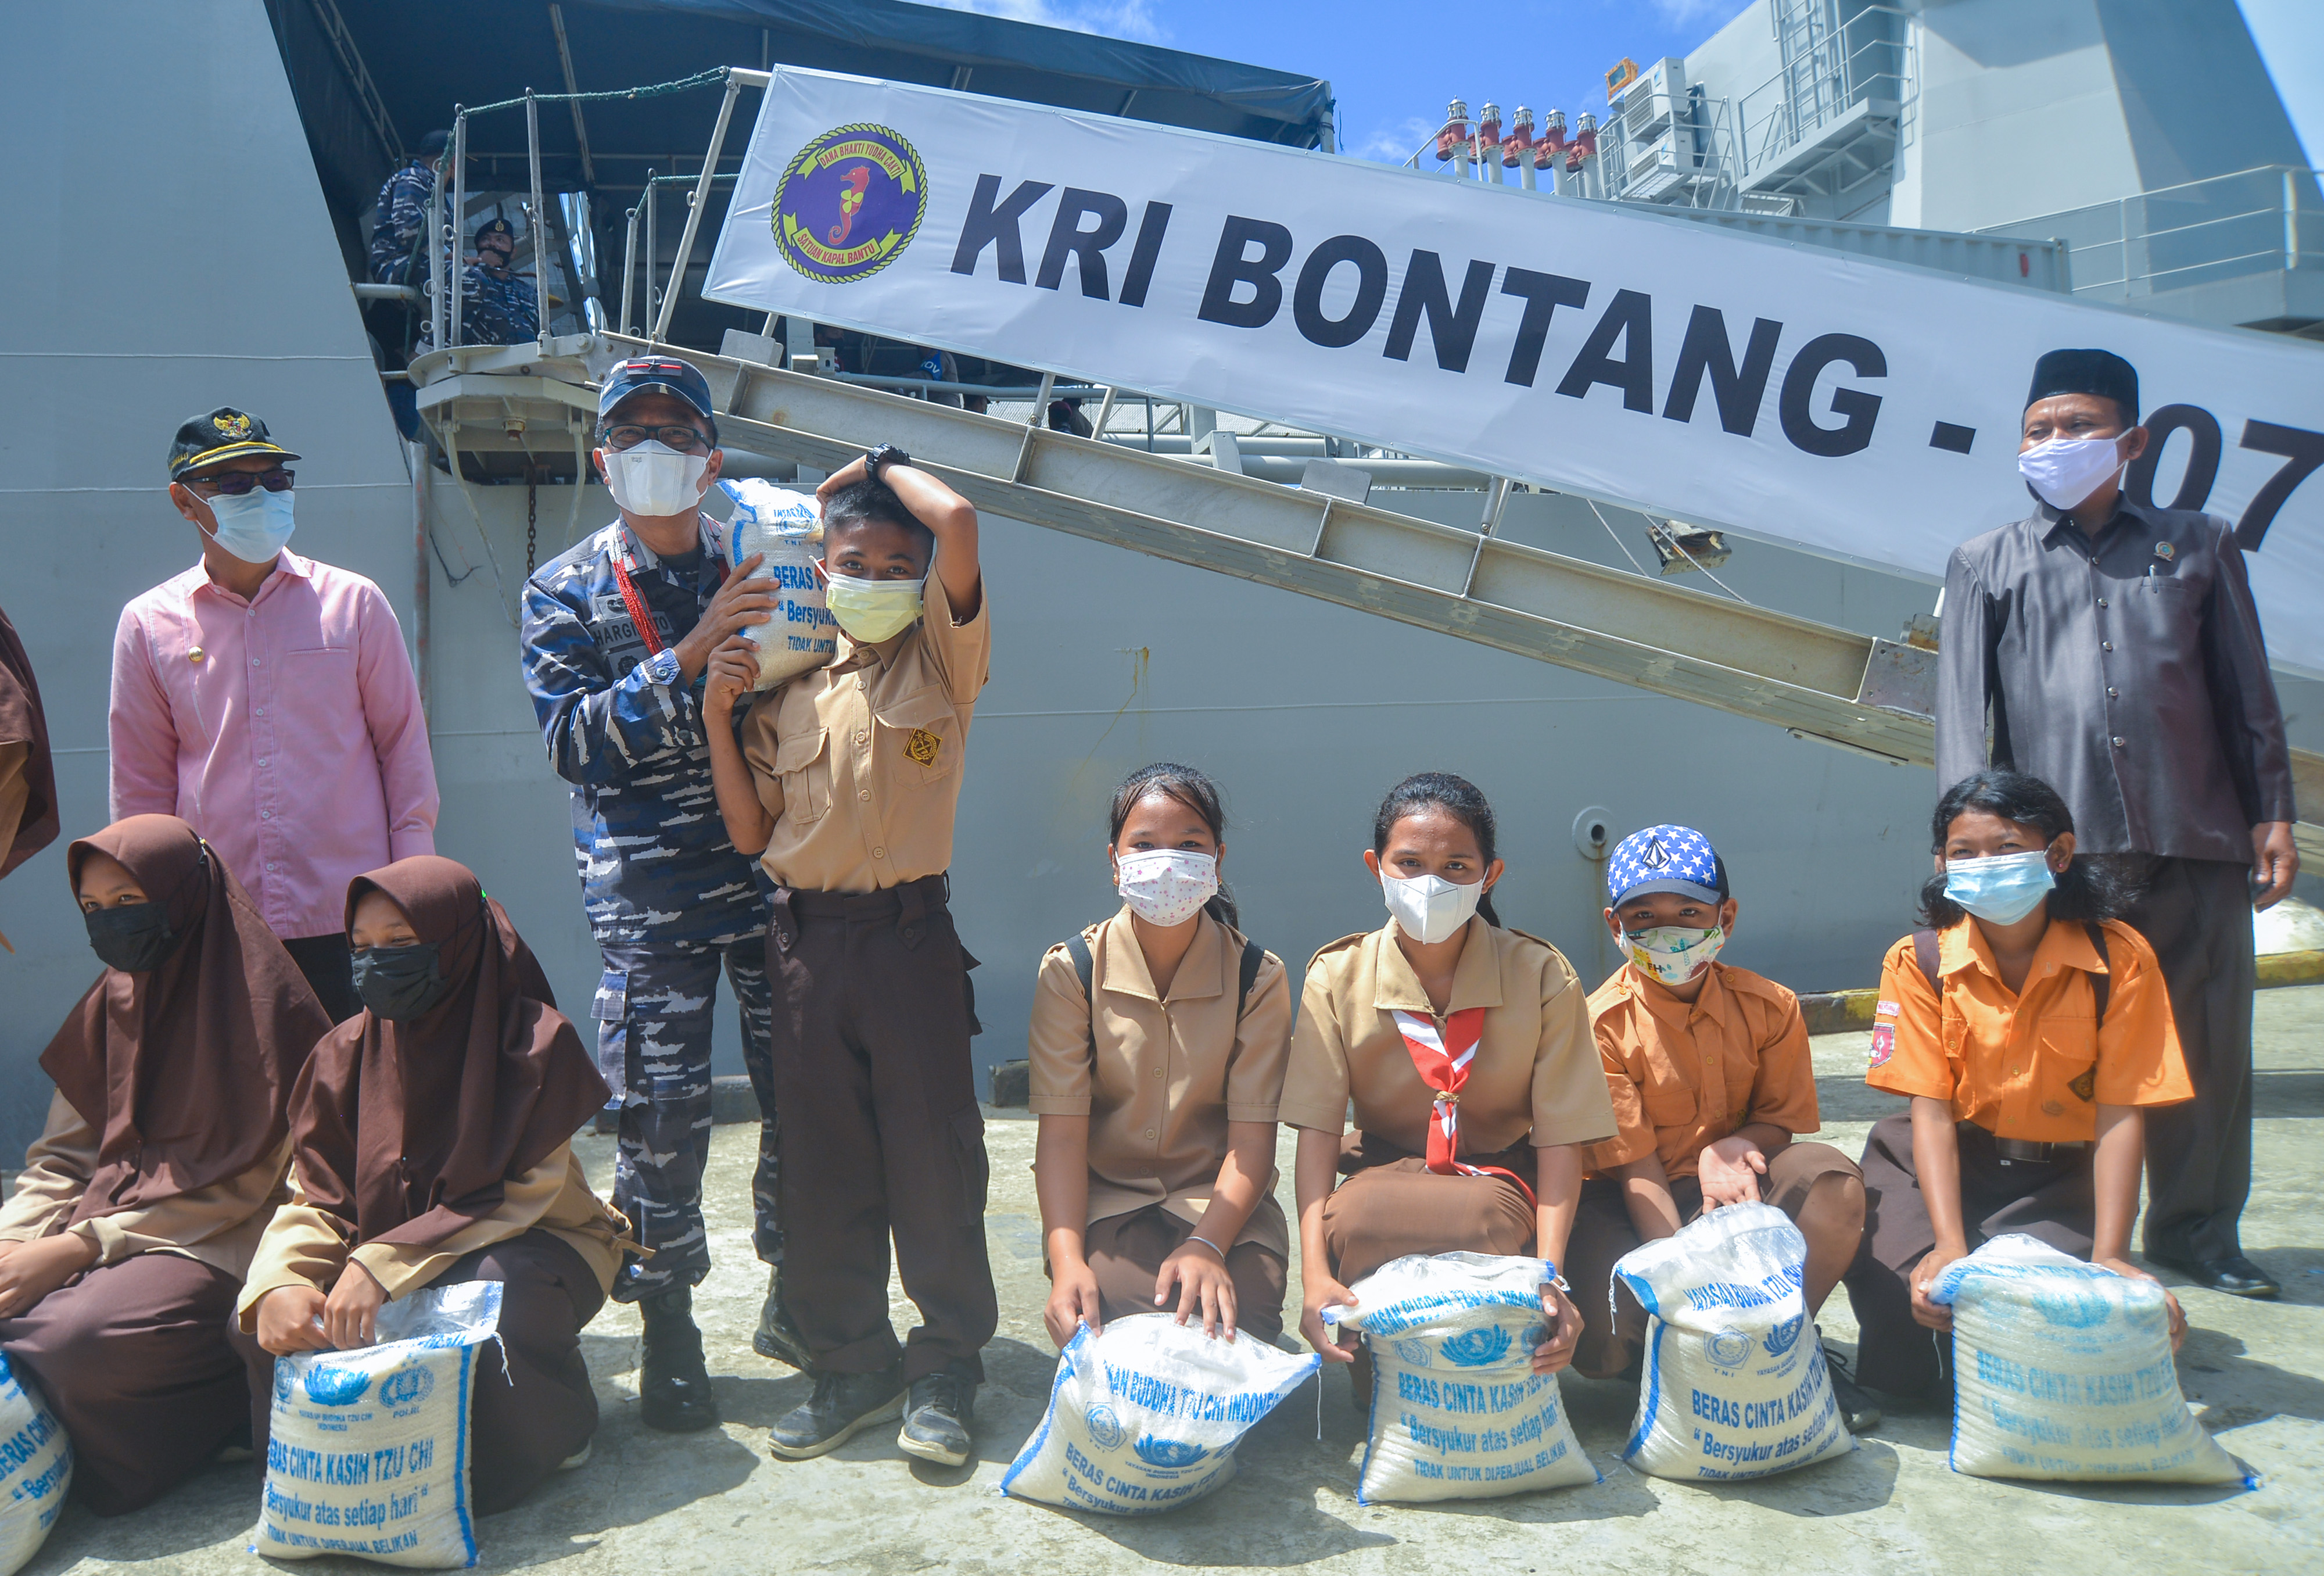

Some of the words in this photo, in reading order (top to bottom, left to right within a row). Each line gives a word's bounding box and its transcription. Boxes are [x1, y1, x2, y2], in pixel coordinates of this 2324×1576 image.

[819, 149, 838, 167] DANA
[840, 142, 864, 156] BHAKTI
[865, 143, 885, 162] YUDHA
[883, 155, 902, 177] CAKTI
[797, 233, 822, 261] SATUAN
[821, 250, 845, 264] KAPAL
[847, 243, 876, 264] BANTU
[950, 173, 1173, 308] KRI
[1197, 214, 1888, 457] BONTANG
[1928, 420, 1977, 454] -
[773, 565, 813, 591] BERAS
[593, 615, 668, 647] HARGITO
[788, 635, 812, 653] TIDAK
[813, 637, 837, 654] UNTU
[1713, 1368, 1734, 1377] TNI
[1204, 1394, 1226, 1421] CHI
[1398, 1371, 1440, 1409] BERAS
[1443, 1382, 1487, 1414] CINTA
[1489, 1382, 1524, 1414] KASIH
[1692, 1388, 1740, 1428] BERAS
[1745, 1398, 1785, 1429] CINTA
[1787, 1372, 1814, 1420] KASIH
[347, 1413, 359, 1421] TZU
[393, 1406, 419, 1419] POLRI
[1410, 1414, 1476, 1456] Bersyukur
[1482, 1428, 1508, 1452] atas
[1510, 1414, 1542, 1447] setiap
[1702, 1432, 1774, 1466] Bersyukur
[1774, 1435, 1800, 1457] atas
[290, 1446, 322, 1483] CINTA
[326, 1452, 370, 1485] KASIH
[374, 1445, 405, 1482] TZU
[408, 1436, 434, 1474] CHI
[1065, 1441, 1104, 1486] BERAS
[1106, 1477, 1146, 1501] CINTA
[1150, 1482, 1196, 1502] KASIH
[1125, 1460, 1152, 1473] YAYASAN
[1414, 1459, 1444, 1480] TIDAK
[1447, 1466, 1482, 1481] UNTUK
[1485, 1458, 1534, 1481] DIPERJUAL
[1535, 1439, 1568, 1470] BELIKAN
[1698, 1466, 1730, 1480] TIDAK
[1731, 1468, 1767, 1480] UNTUK
[315, 1499, 340, 1527] atas
[344, 1498, 386, 1531] setiap
[390, 1486, 418, 1521] hari
[1067, 1475, 1131, 1514] Bersyukur
[288, 1532, 320, 1549] UNTUK
[320, 1537, 374, 1554] DIPERJUAL
[372, 1530, 419, 1554] BELIKAN
